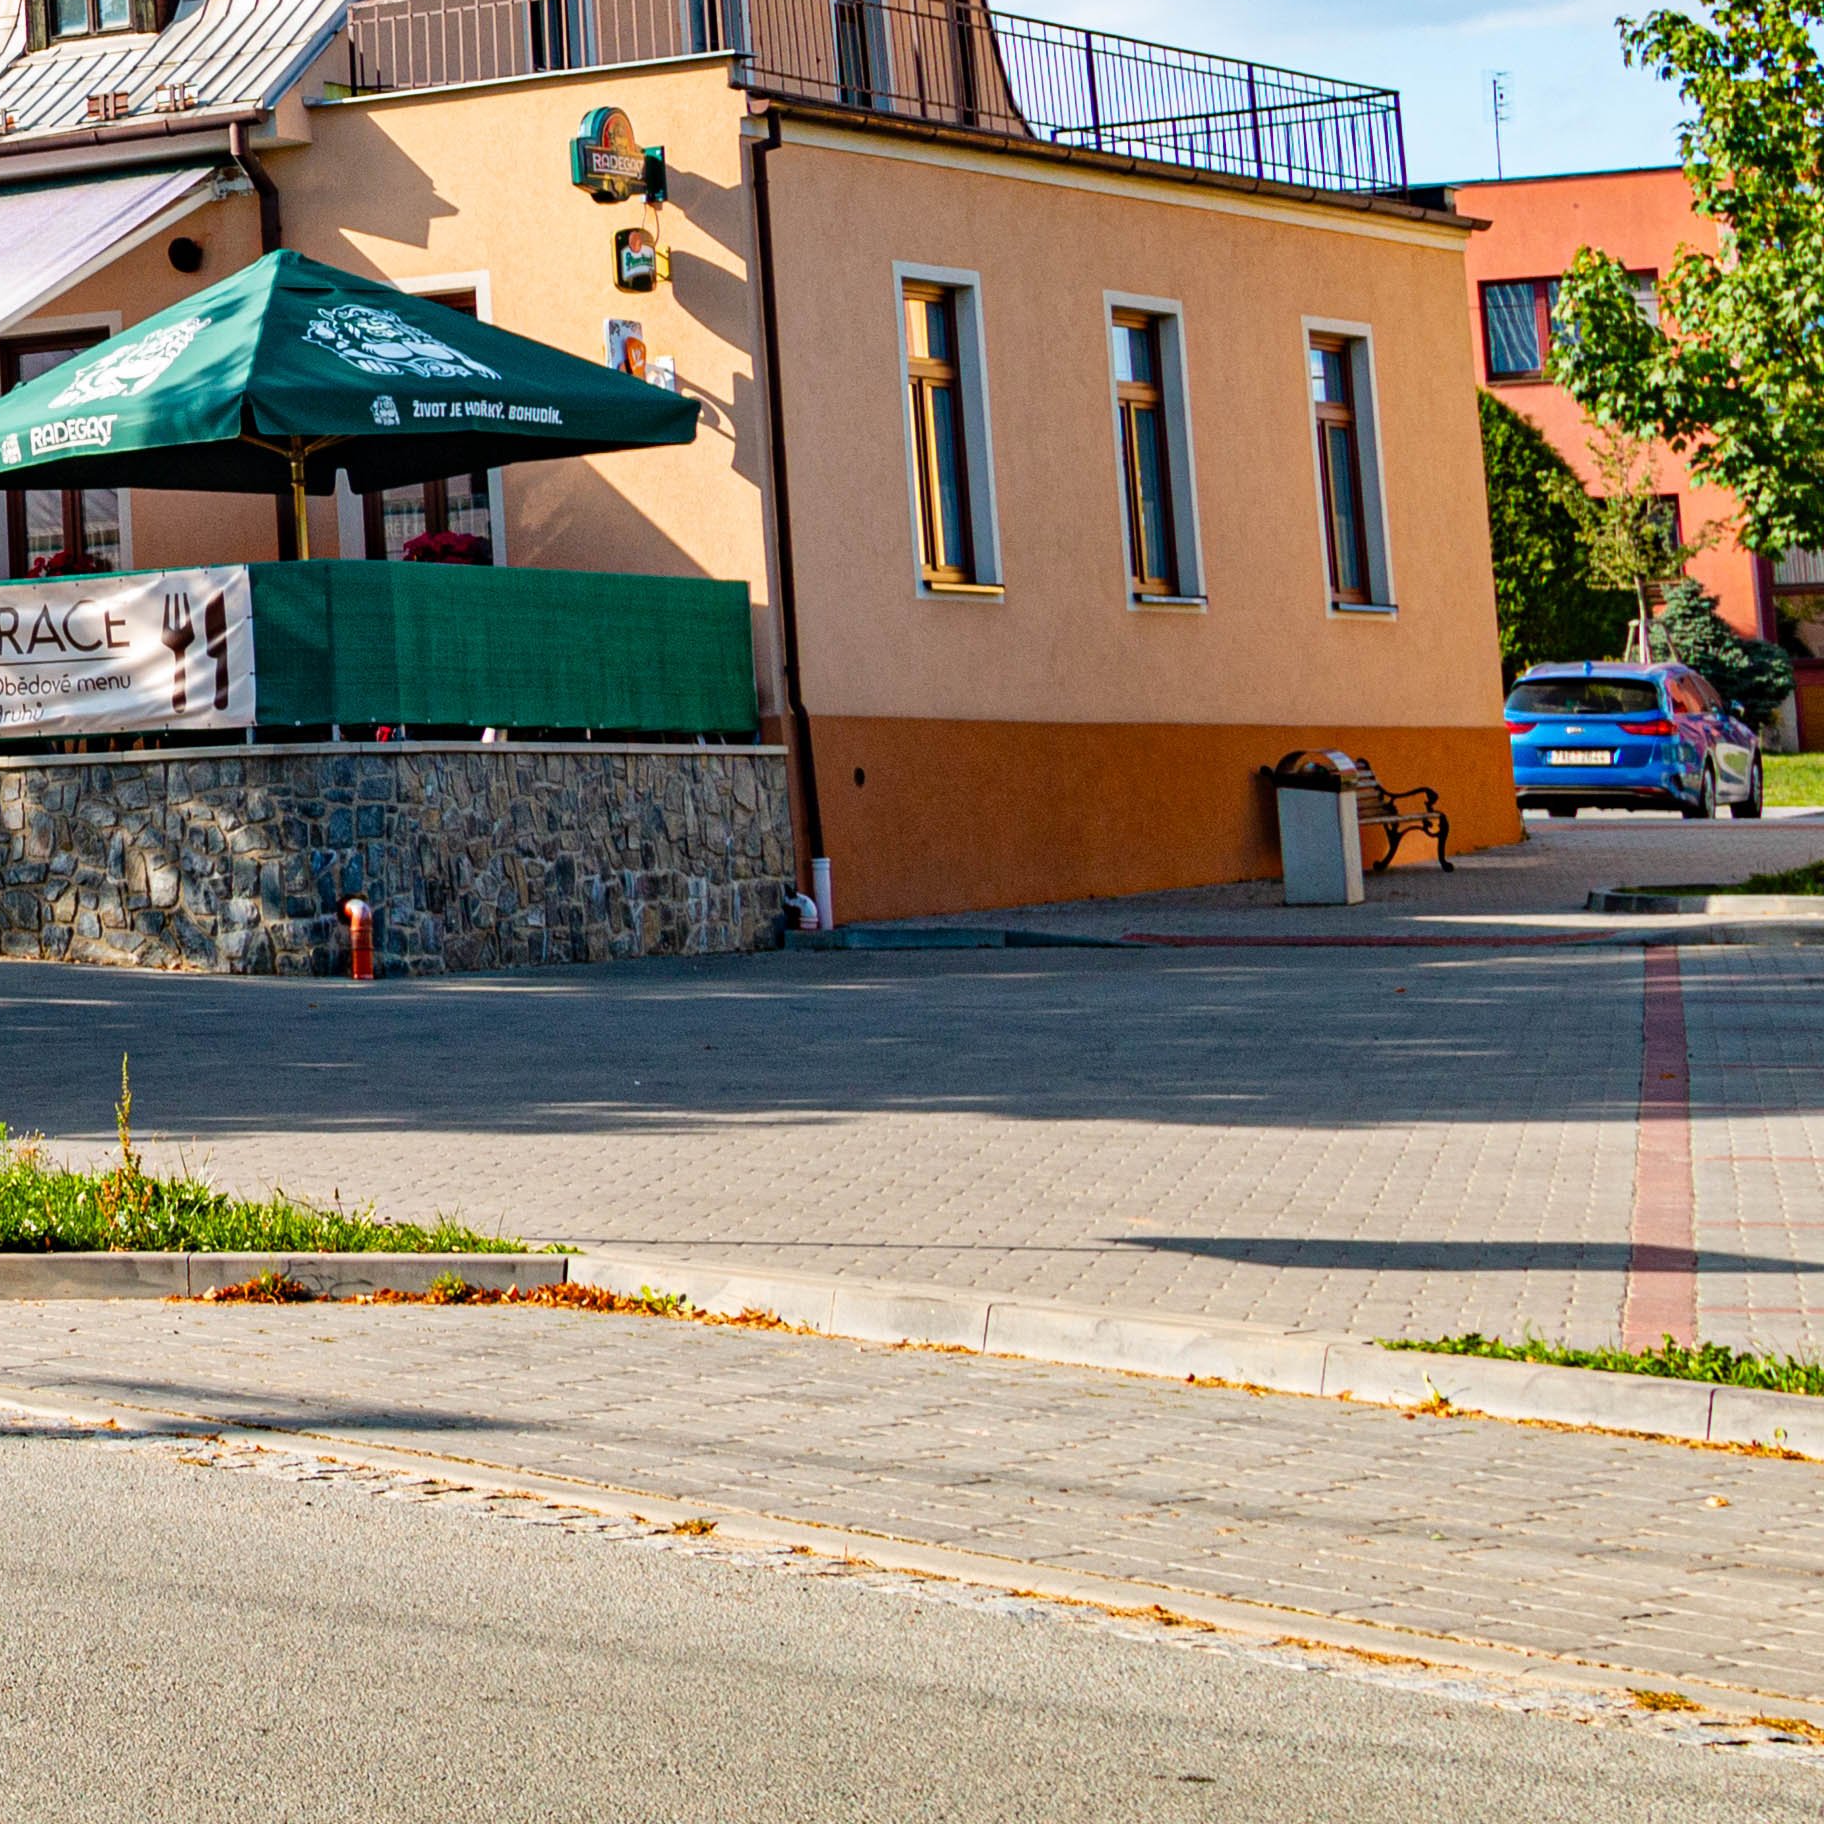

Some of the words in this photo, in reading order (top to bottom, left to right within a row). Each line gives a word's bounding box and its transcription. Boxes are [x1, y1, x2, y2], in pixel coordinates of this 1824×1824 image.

[412, 399, 447, 418] ŽIVOT
[449, 401, 462, 418] JE
[464, 399, 505, 419] HOŘKÝ.
[508, 405, 563, 425] BOHUDÍK.
[30, 414, 118, 456] RADEGAST
[77, 674, 132, 693] menu
